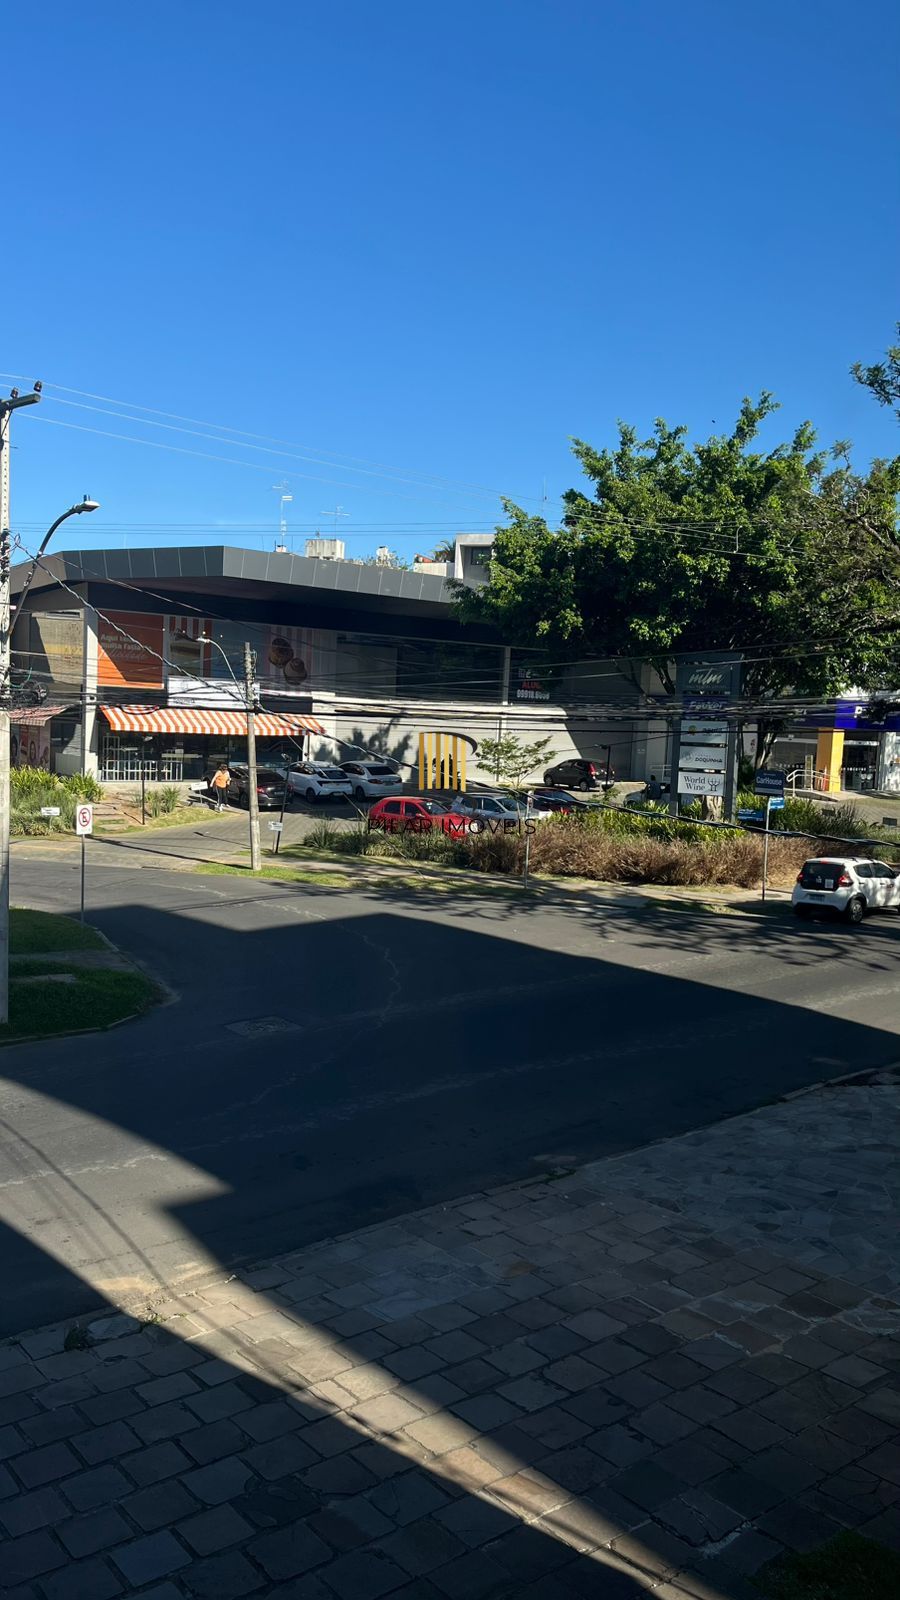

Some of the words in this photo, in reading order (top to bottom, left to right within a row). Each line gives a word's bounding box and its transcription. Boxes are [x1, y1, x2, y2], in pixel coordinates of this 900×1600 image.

[683, 776, 706, 784] World
[756, 776, 783, 786] CarHouse
[685, 783, 706, 791] Wine
